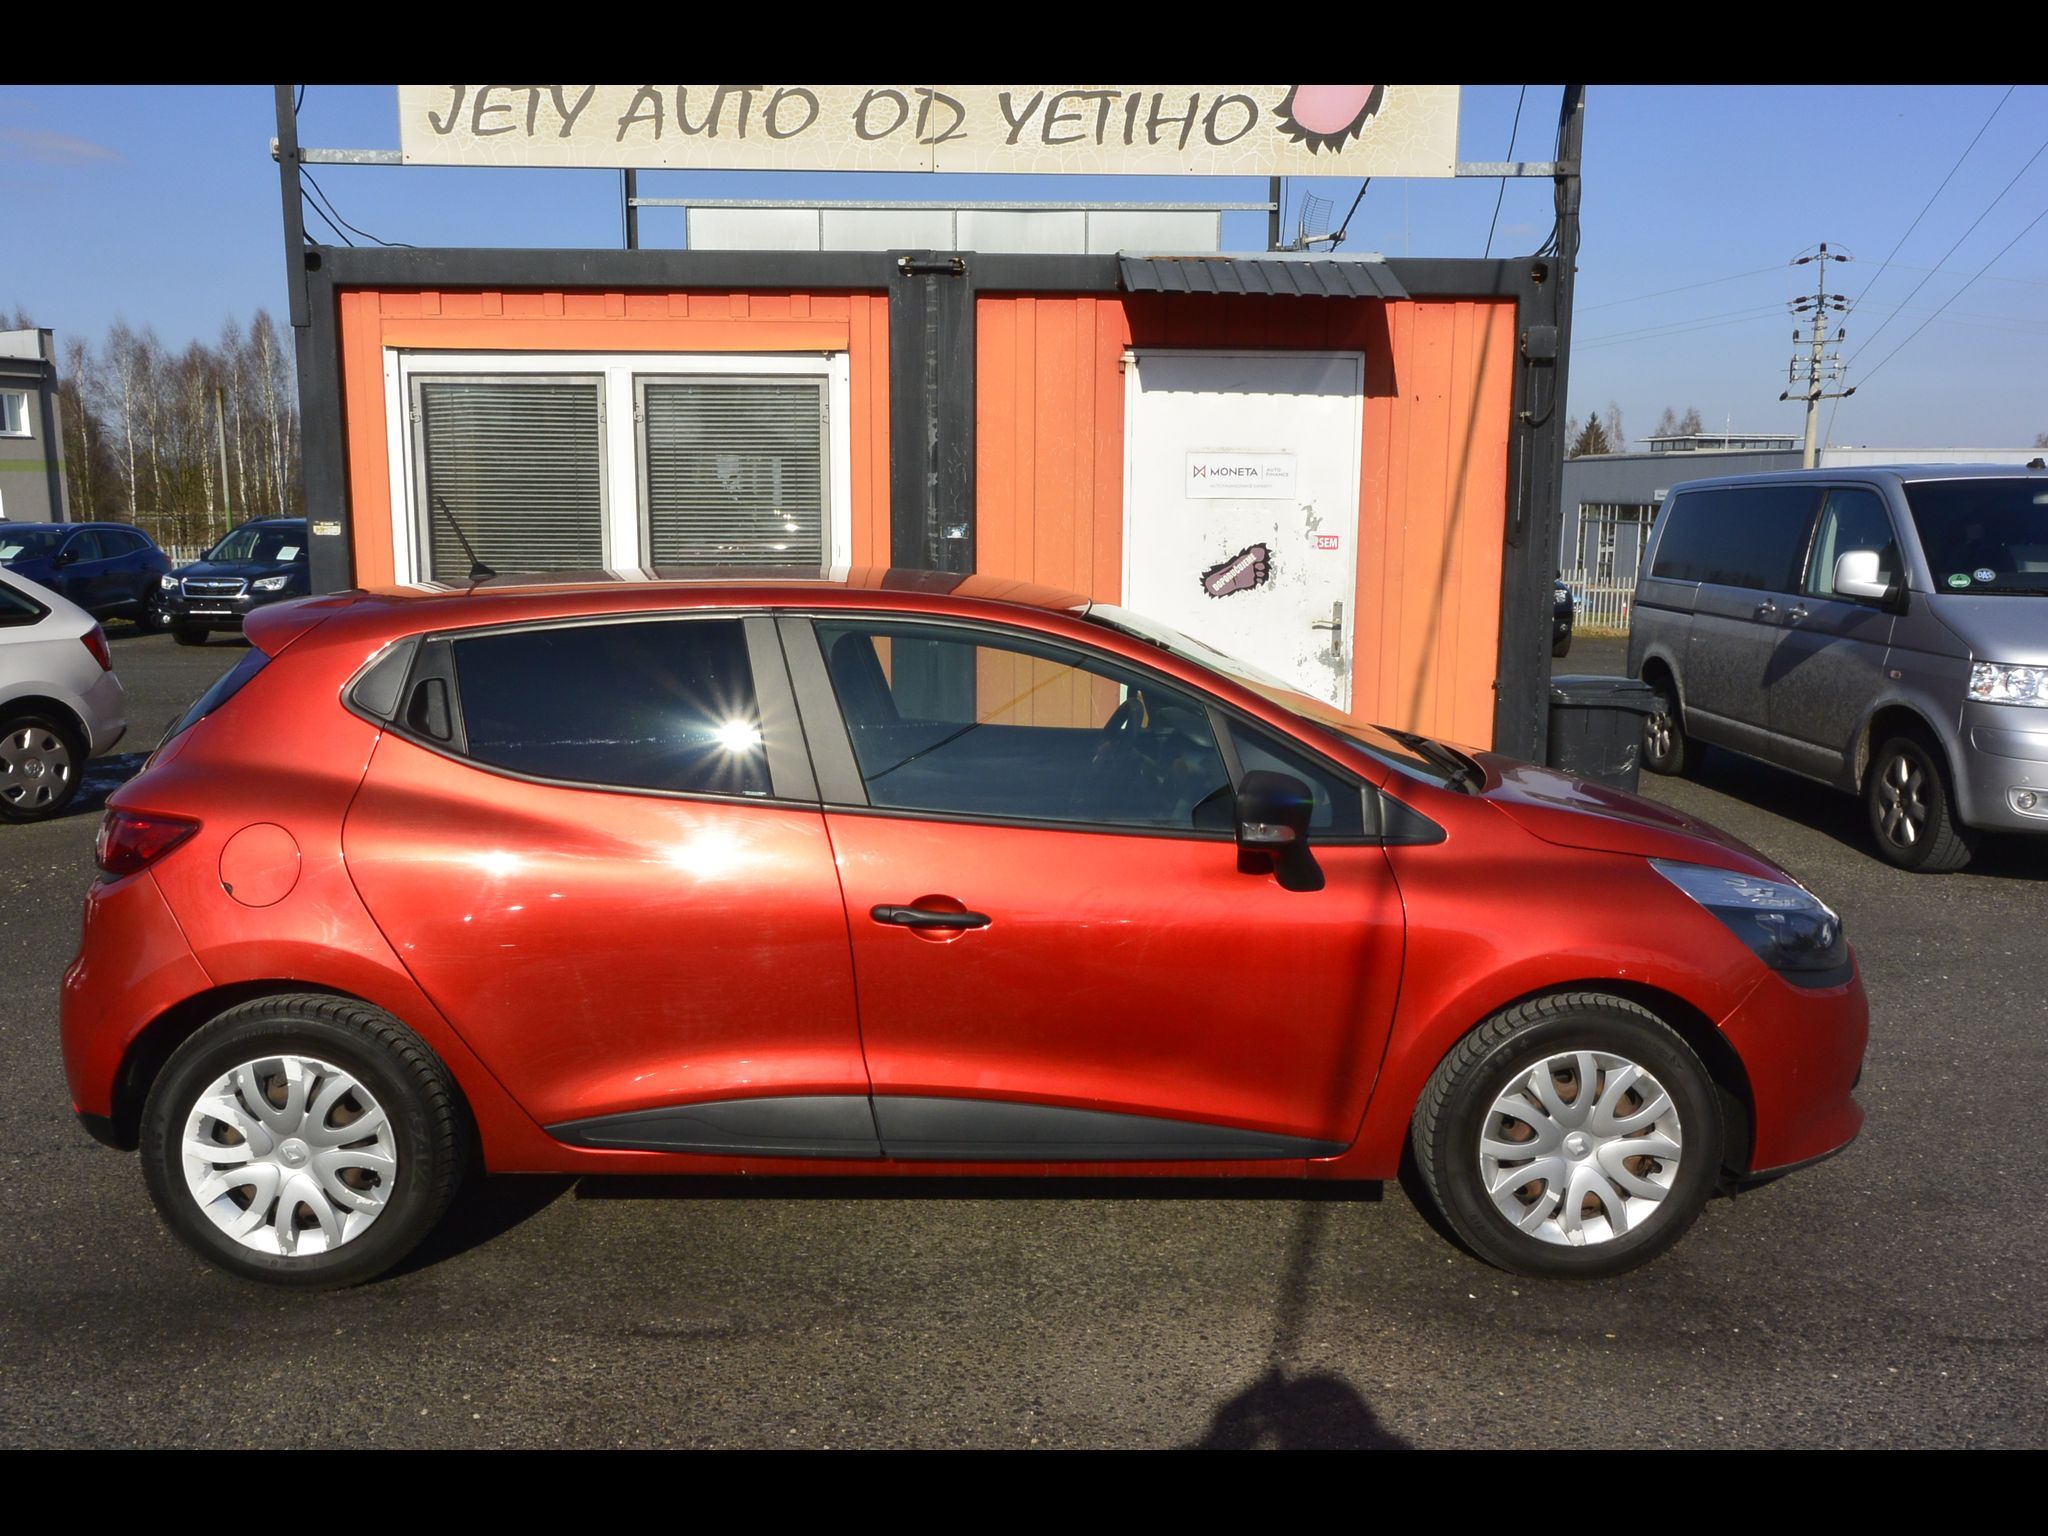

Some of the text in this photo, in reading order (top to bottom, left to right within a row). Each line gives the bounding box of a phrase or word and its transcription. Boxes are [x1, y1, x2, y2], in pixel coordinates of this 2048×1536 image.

[615, 85, 820, 142] AUTO
[851, 87, 968, 145] OD
[998, 90, 1259, 151] YETIHO
[1210, 467, 1258, 477] MONETA
[1318, 537, 1338, 549] SEM
